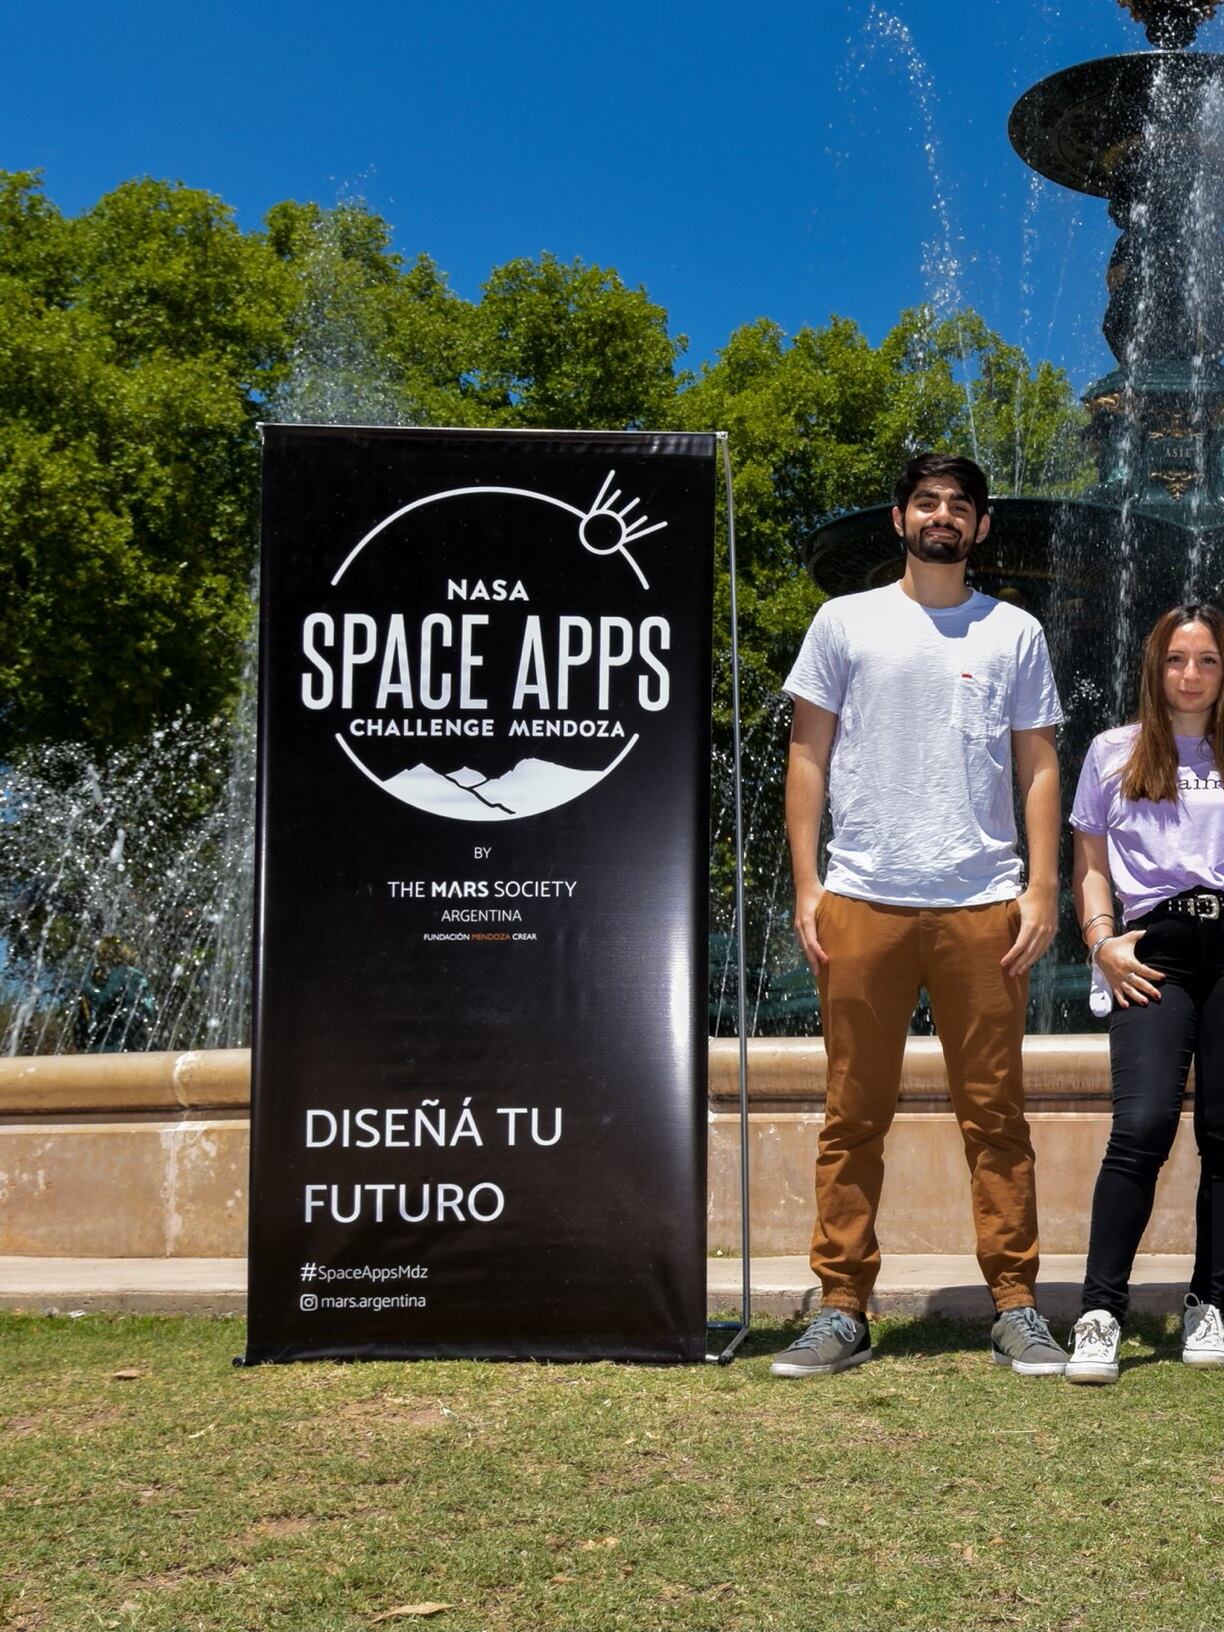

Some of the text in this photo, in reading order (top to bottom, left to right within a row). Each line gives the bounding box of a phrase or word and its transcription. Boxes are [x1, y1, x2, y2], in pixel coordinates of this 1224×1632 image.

[447, 579, 530, 602] NASA
[301, 612, 672, 712] SPACE APPS
[349, 718, 626, 738] CHALLENGE MENDOZA
[474, 846, 492, 859] BY
[387, 880, 578, 899] THE MARS SOCIETY
[440, 909, 523, 923] ARGENTINA
[423, 931, 538, 942] FUNDACIÓN MENDOZA CREAR
[305, 1097, 564, 1148] DISEÑÁ TU
[304, 1182, 506, 1224] FUTURO
[300, 1262, 430, 1284] #SpaceAppsMdz
[321, 1293, 427, 1313] mars.argentina
